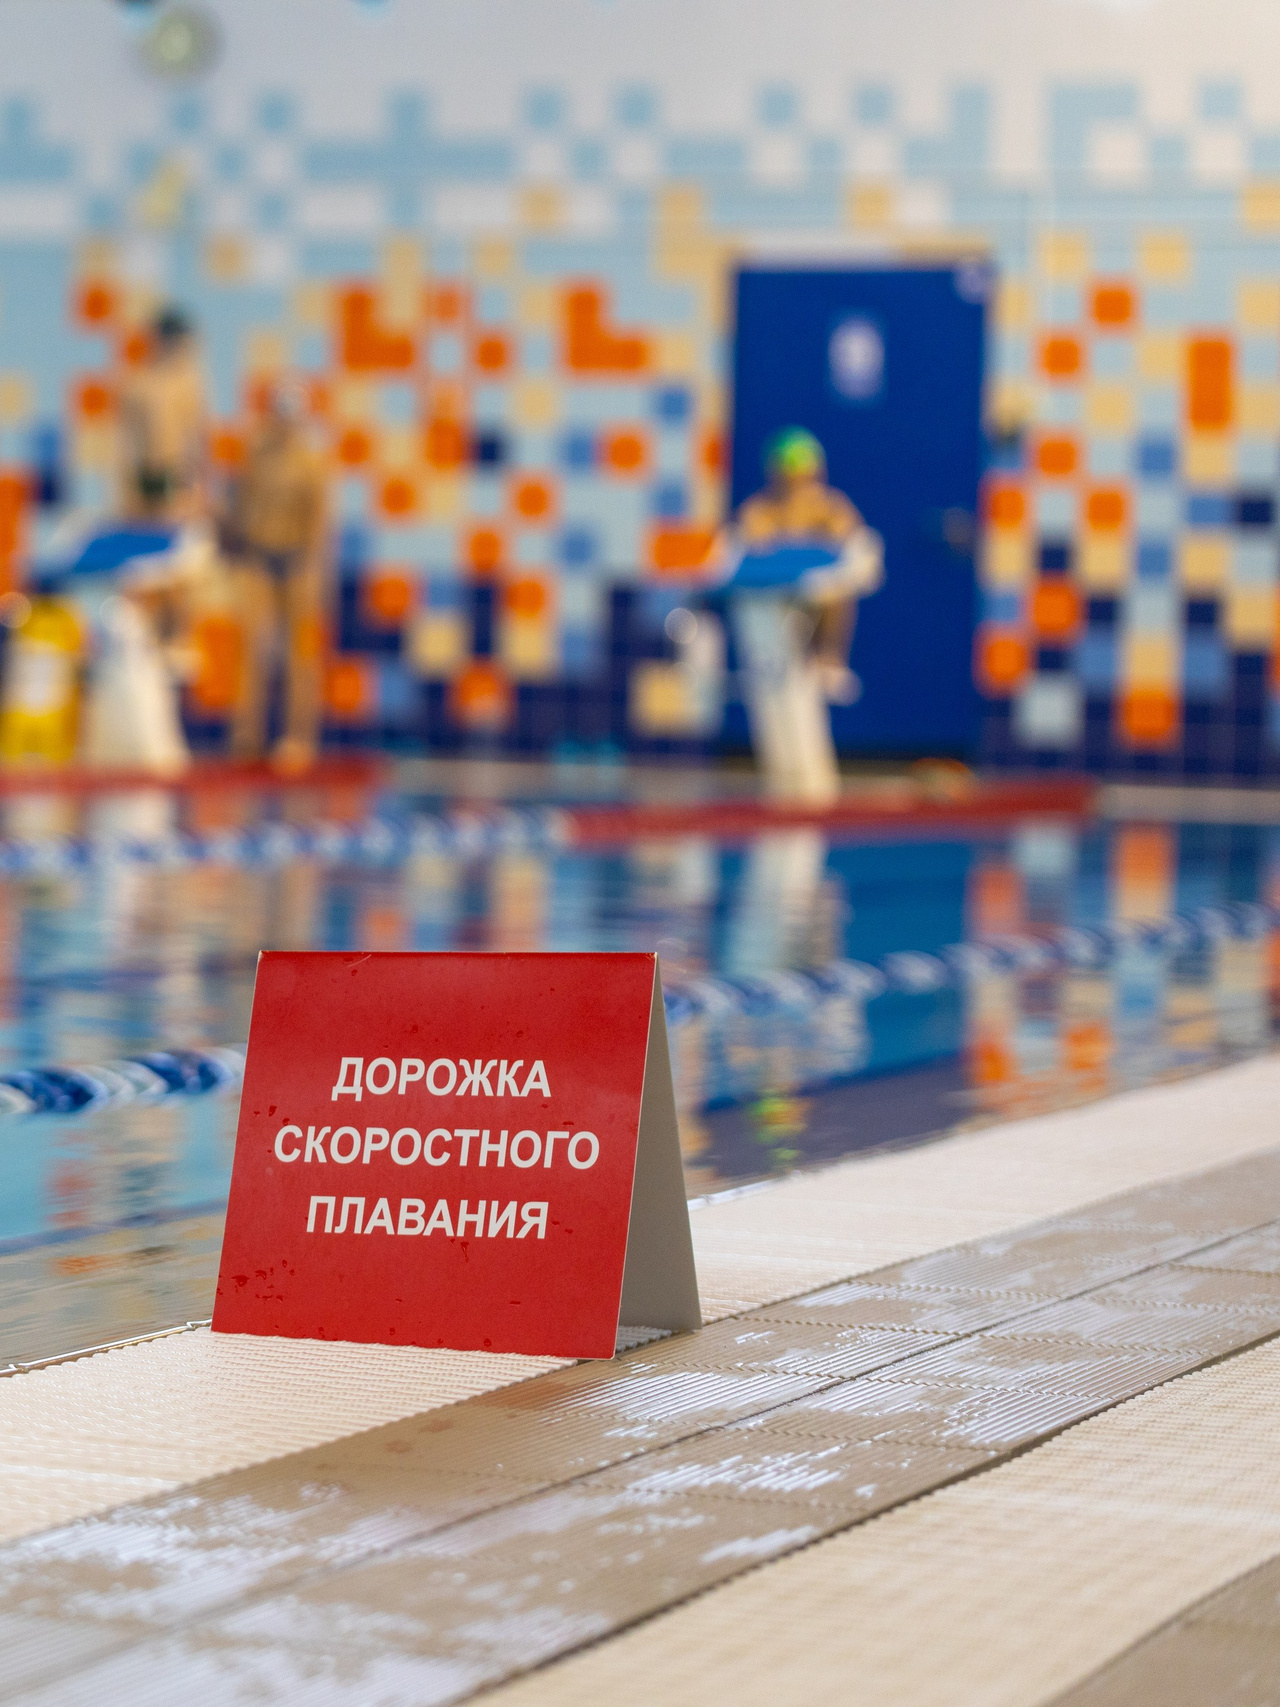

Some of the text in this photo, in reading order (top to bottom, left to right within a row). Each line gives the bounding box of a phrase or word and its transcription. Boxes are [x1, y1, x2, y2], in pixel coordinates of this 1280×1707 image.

[331, 1057, 552, 1102] ДОРОЖКА
[274, 1124, 600, 1170] СКОРОСТНОГО
[306, 1195, 549, 1239] ПЛАВАНИЯ
